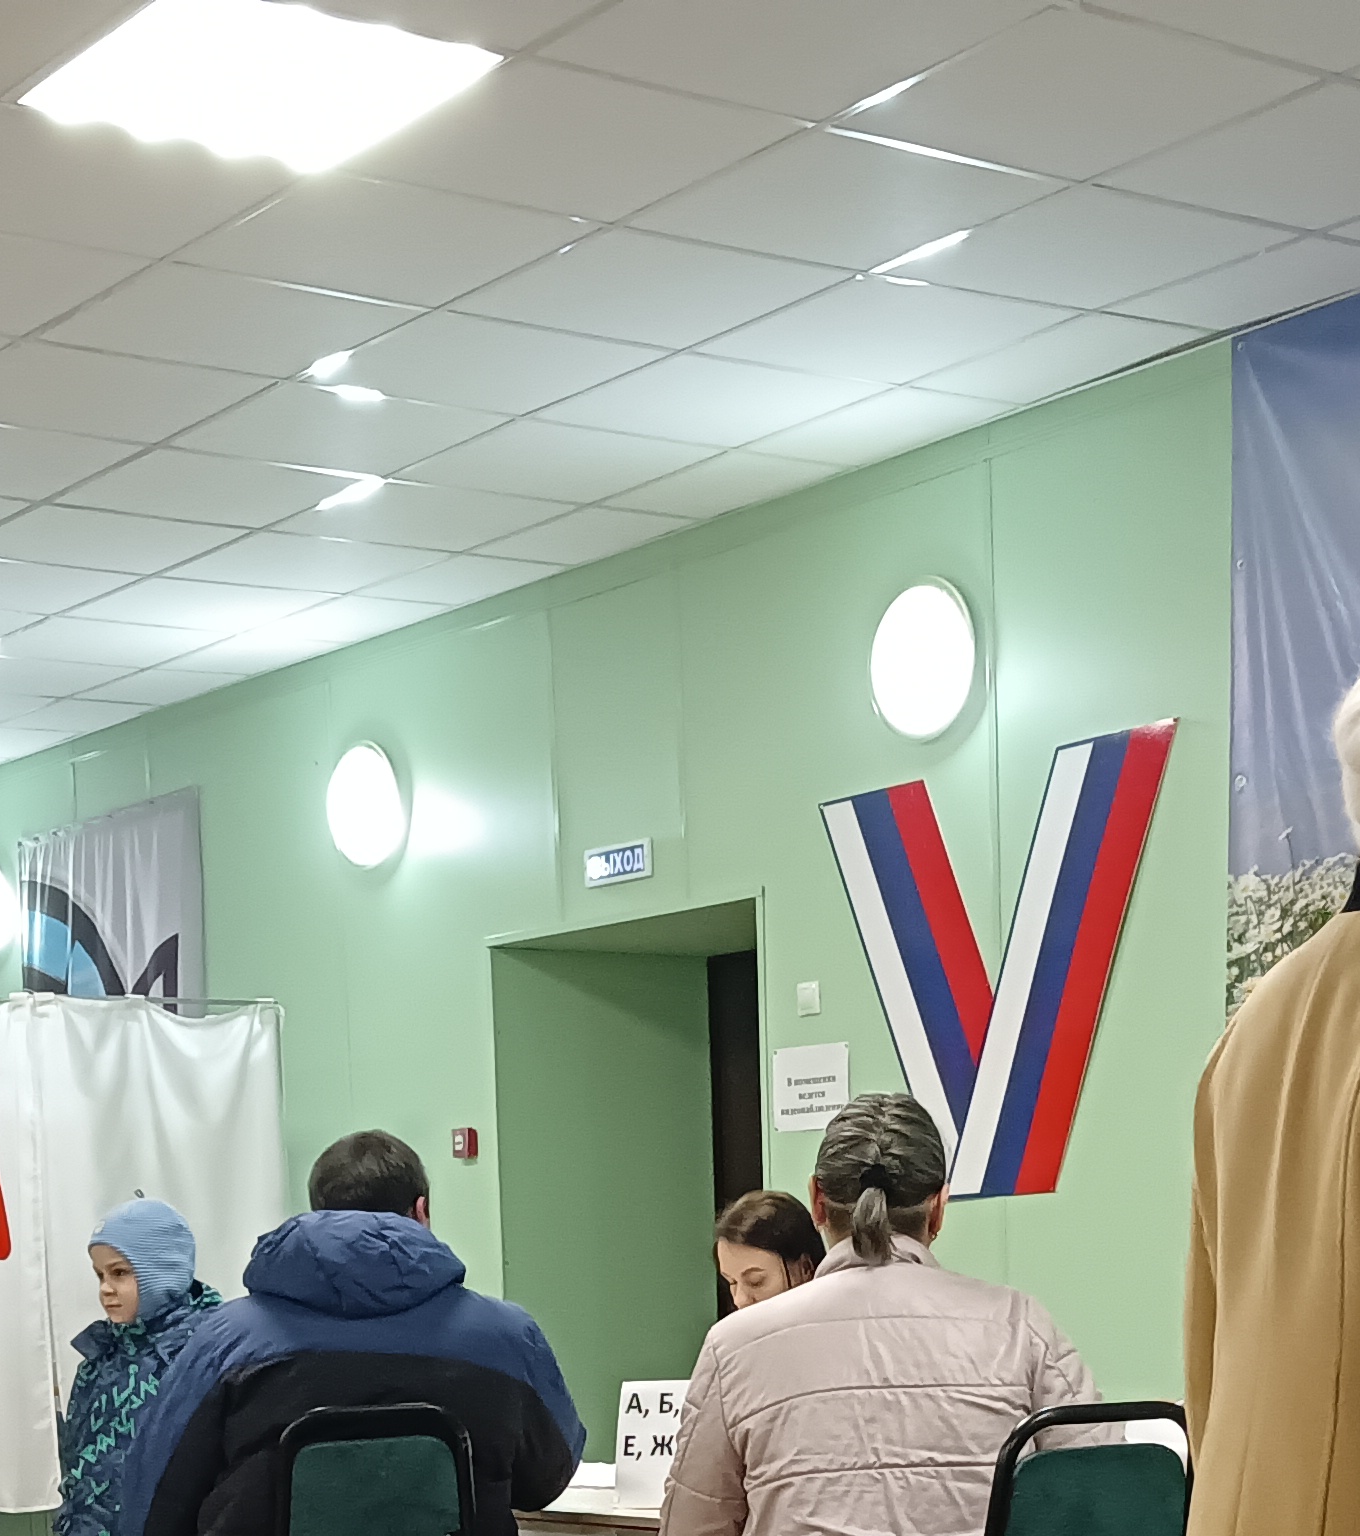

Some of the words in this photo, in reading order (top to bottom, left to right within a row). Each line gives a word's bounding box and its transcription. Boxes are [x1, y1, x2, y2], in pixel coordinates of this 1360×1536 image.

[587, 847, 644, 879] ЫХОД
[625, 1393, 649, 1418] А,
[659, 1393, 679, 1418] Б,
[624, 1435, 642, 1461] Е,
[650, 1435, 674, 1456] Ж
